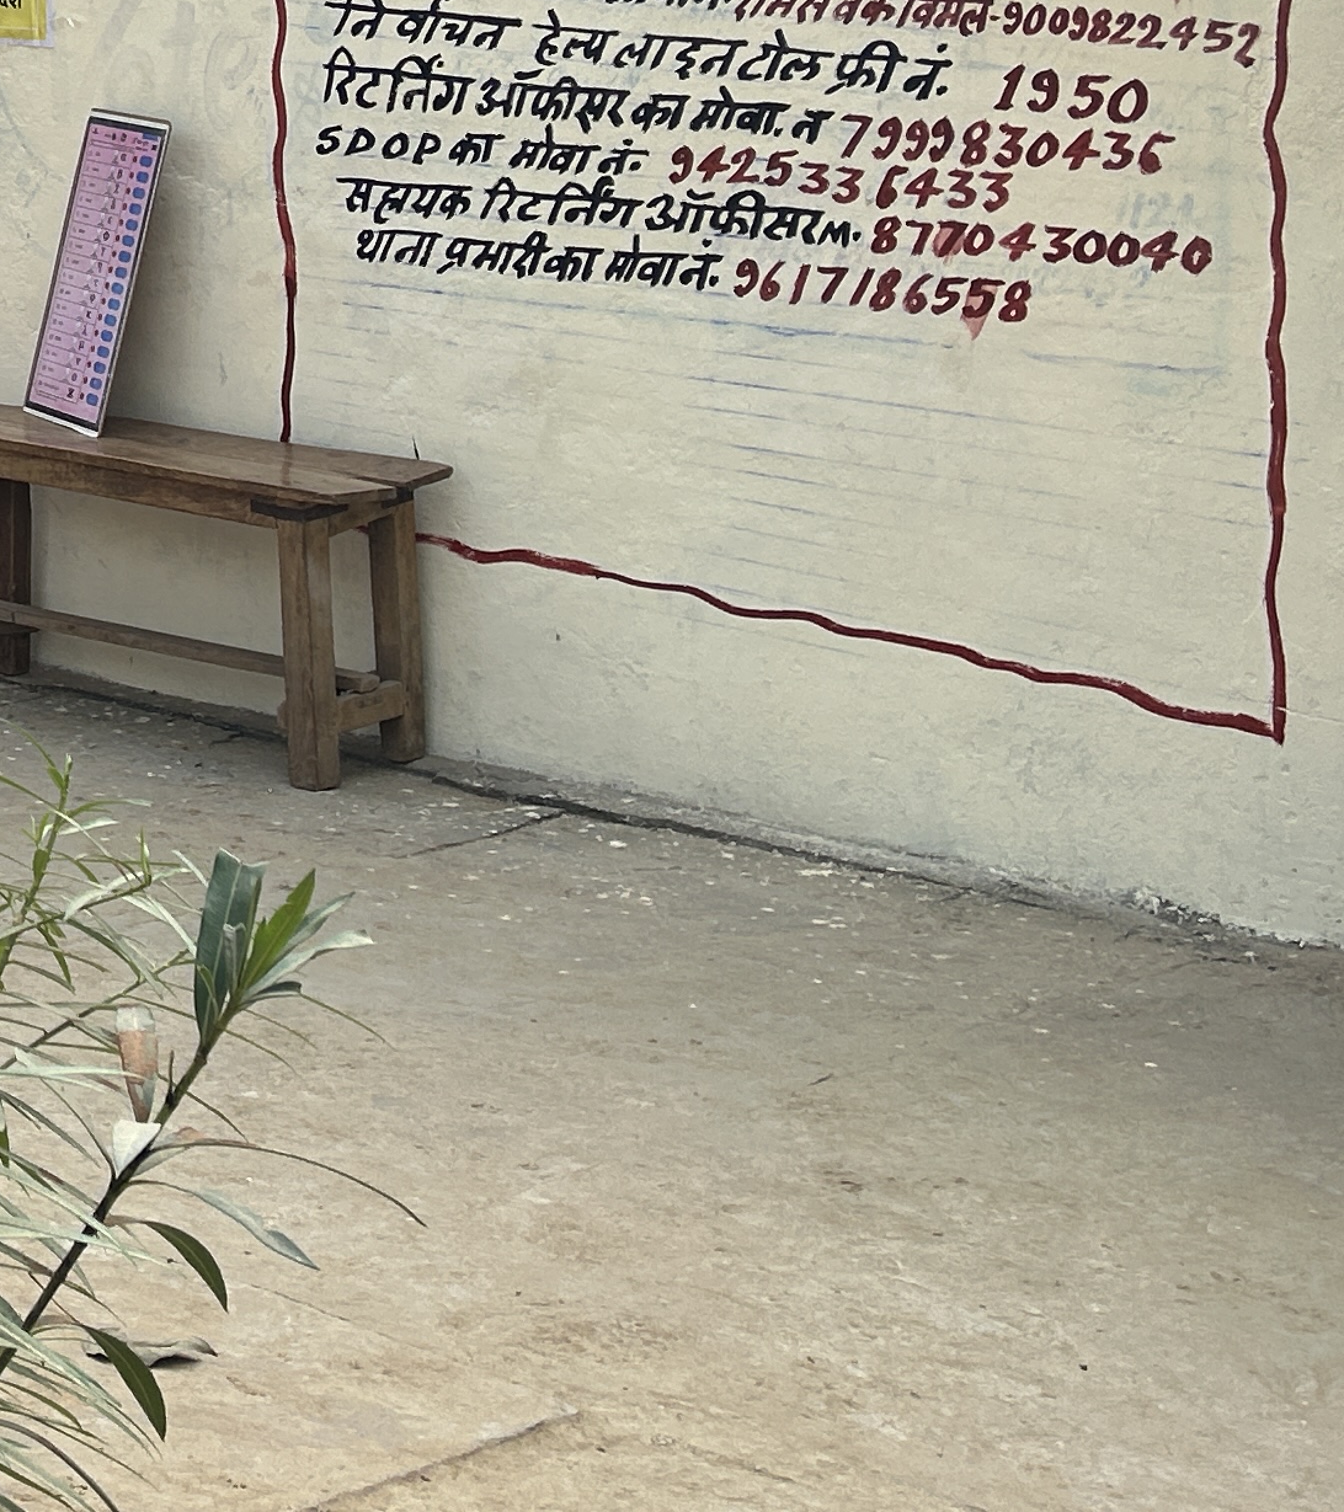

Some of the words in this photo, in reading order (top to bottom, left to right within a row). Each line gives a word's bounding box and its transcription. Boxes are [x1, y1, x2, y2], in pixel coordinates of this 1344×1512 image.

[994, 64, 1149, 124] 1950
[316, 125, 441, 164] SDOP
[449, 133, 505, 165] का
[631, 94, 691, 134] का
[841, 113, 1175, 174] 7999830436
[870, 215, 1214, 275] 8770430040
[357, 229, 443, 267] थाना
[543, 247, 604, 281] का
[733, 259, 1032, 322] 9617186558
